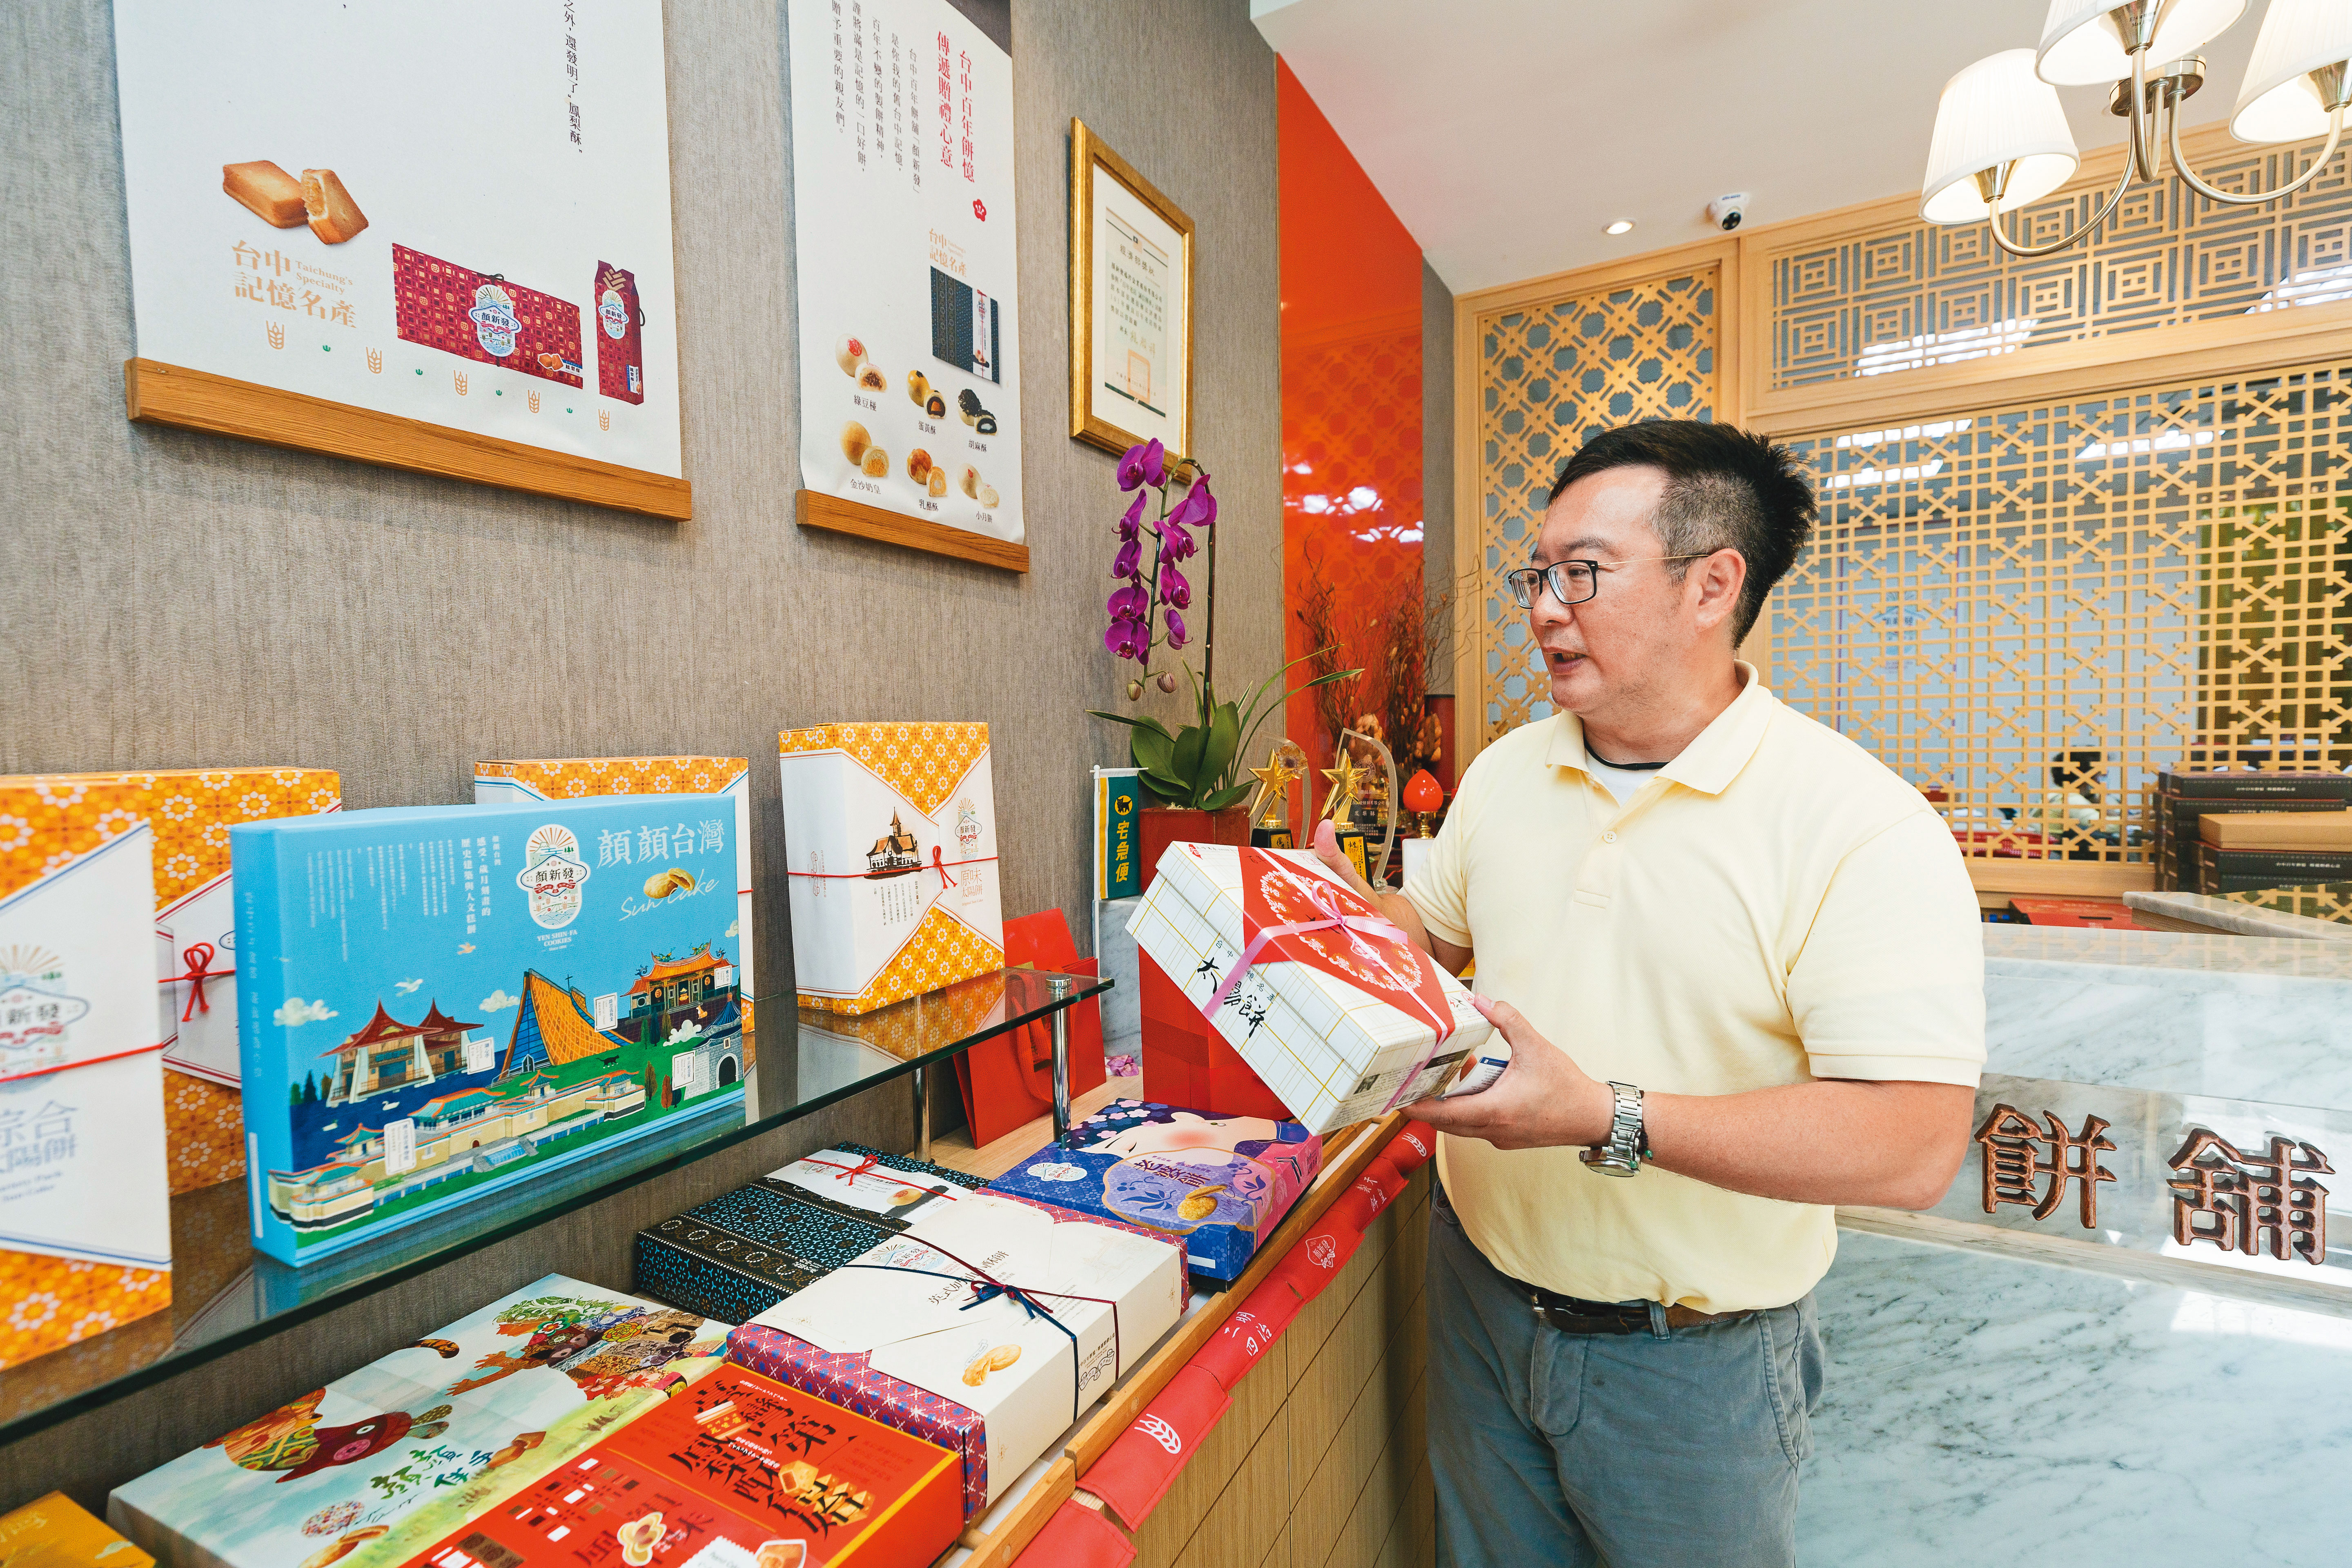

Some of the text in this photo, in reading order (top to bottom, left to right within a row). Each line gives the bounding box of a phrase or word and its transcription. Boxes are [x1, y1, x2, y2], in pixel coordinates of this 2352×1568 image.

[937, 31, 953, 168] 傳遞贈禮心意
[960, 50, 975, 183] 台中百年餅憶
[929, 227, 947, 249] 台中
[232, 239, 290, 276] 台中
[930, 245, 967, 277] 記憶名產
[295, 261, 353, 285] Taichung's
[296, 272, 345, 295] Specialty
[233, 271, 356, 328] 記憶名產
[481, 312, 510, 327] 顏新發
[918, 420, 936, 435] 蛋黃酥
[968, 439, 987, 453] 胡麻酥
[850, 478, 881, 495] 金沙奶皇
[918, 499, 939, 512] 乳酪酥
[976, 510, 993, 524] 小月餅
[960, 824, 976, 834] 顏新發
[596, 819, 726, 869] 顏顏台灣
[1116, 820, 1129, 883] 宅急便
[1247, 855, 1287, 866] 百年店
[536, 868, 574, 883] 顏新發
[961, 867, 982, 887] 原味
[619, 869, 720, 922] Sun Cake
[961, 884, 983, 899] 太陽餅
[544, 937, 572, 947] COOKIES
[551, 929, 577, 939] SHIN-FA
[1216, 940, 1274, 1004] 台中憶名產
[1134, 1159, 1211, 1187] 老婆餅
[1974, 1102, 2336, 1265] 餅舖
[1313, 1239, 1330, 1259] 顏新發
[942, 1261, 957, 1272] SHIN-F
[949, 1290, 967, 1302] British
